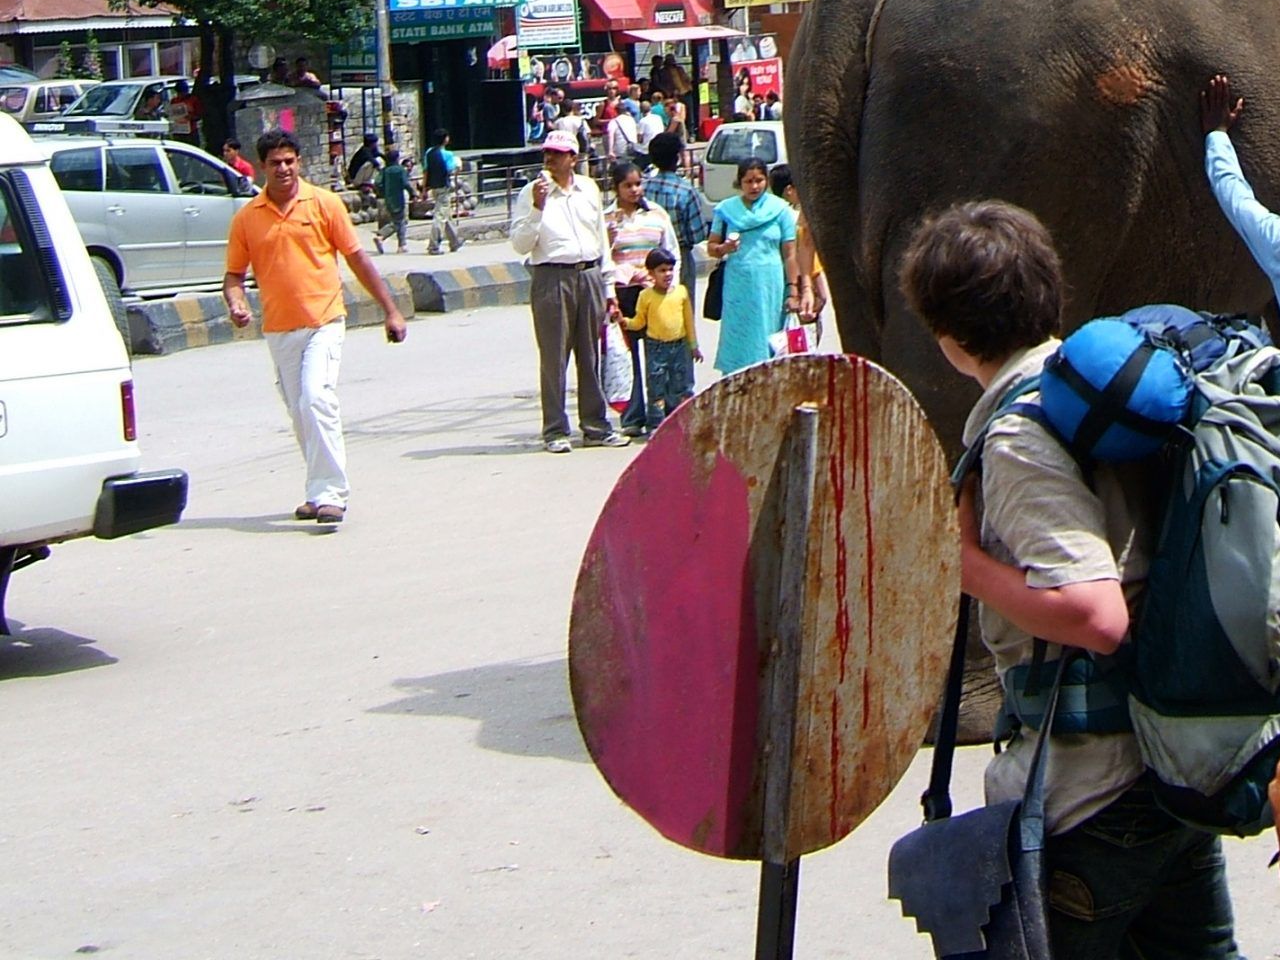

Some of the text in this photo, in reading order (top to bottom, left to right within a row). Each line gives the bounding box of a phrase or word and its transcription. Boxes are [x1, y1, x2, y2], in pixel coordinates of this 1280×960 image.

[391, 22, 494, 39] STATE BANK ATM
